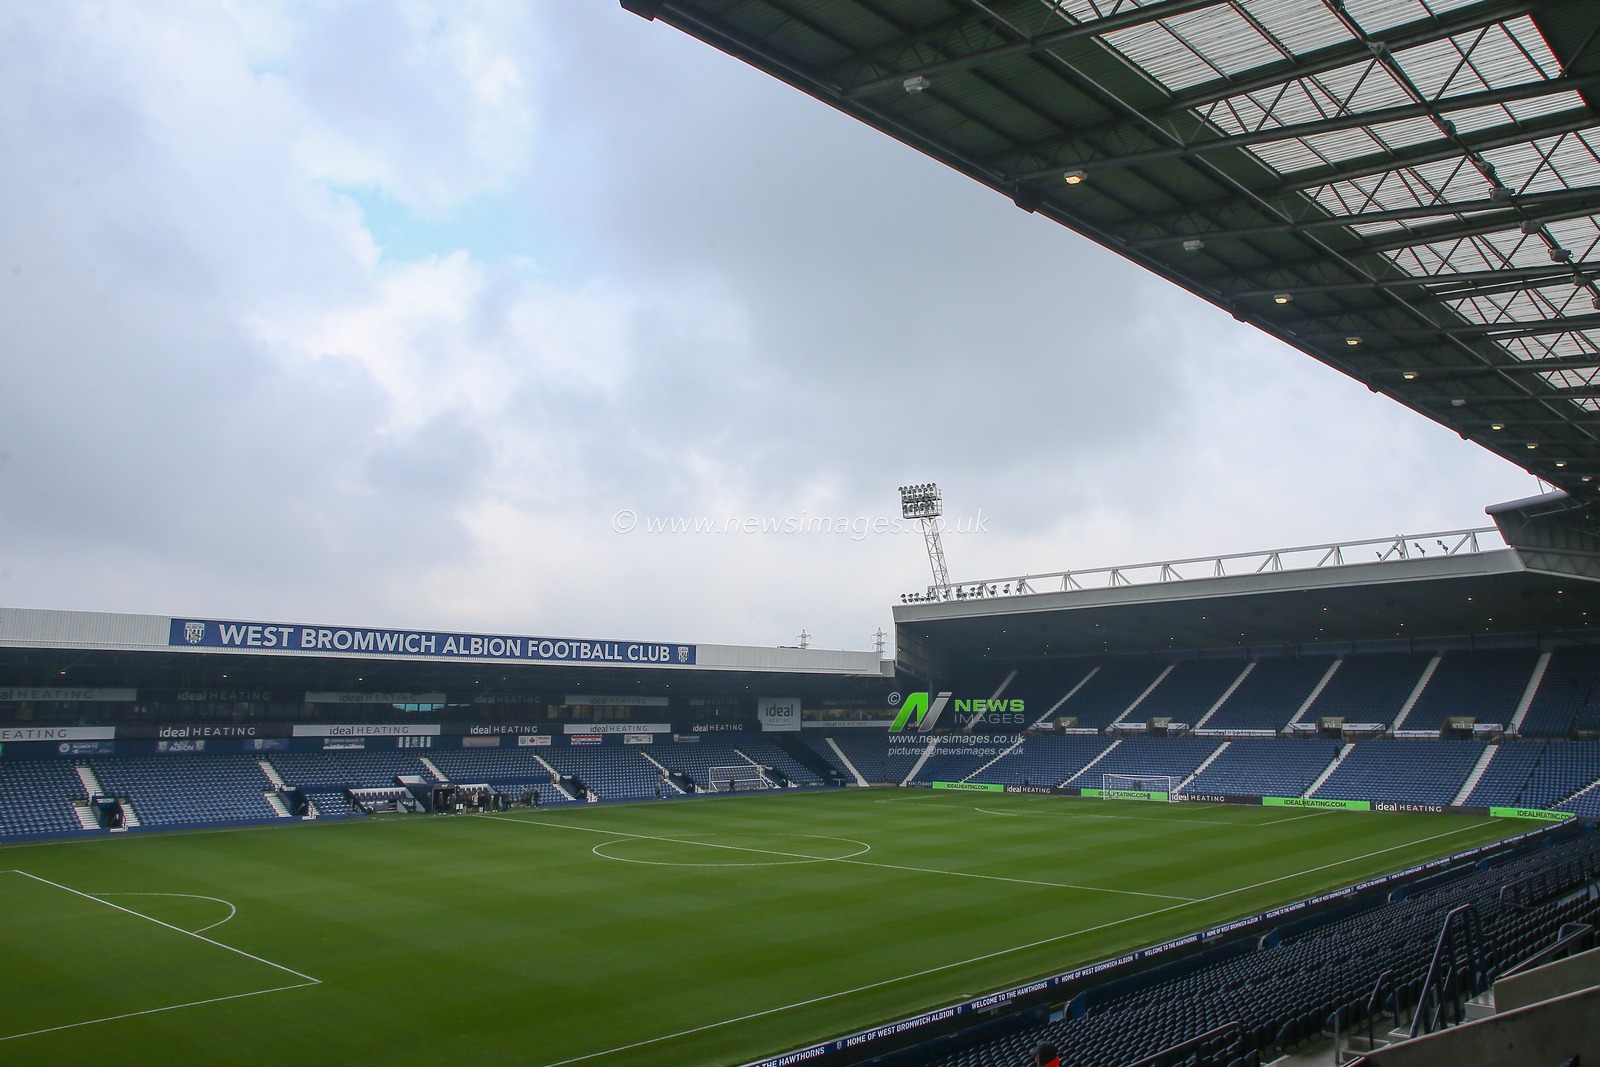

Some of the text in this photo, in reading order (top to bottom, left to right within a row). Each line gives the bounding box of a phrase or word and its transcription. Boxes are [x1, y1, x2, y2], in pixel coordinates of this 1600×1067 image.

[218, 624, 670, 662] WEST BROMWICH ALBION FOOTBALL CLUB
[17, 690, 93, 700] HEATING
[177, 691, 271, 701] ideal HEATING
[339, 693, 417, 703] ideal HEATING
[474, 695, 541, 704] ideal HEATING
[589, 697, 647, 705] ideal HEATING
[689, 698, 739, 706] ideal HEATING
[765, 704, 794, 717] ideal
[159, 726, 256, 738] ideal HEATING
[329, 725, 409, 736] ideal HEATING
[470, 725, 538, 734] ideal HEATING
[590, 725, 608, 733] ideal
[692, 724, 709, 732] ideal
[947, 783, 989, 791] IDEALHEATING.COM
[1006, 785, 1021, 793] ideal
[1172, 793, 1189, 801] ideal
[1283, 799, 1347, 808] IDEALHEATING.COM
[1375, 802, 1442, 813] ideal HEATING
[1061, 973, 1075, 983] HOME
[1081, 967, 1094, 977] WEST
[971, 981, 1048, 1010] WELCOME TO THE HAWTHORNS
[847, 1009, 954, 1047] HOME OF WEST BROMWICH ALBION
[779, 1046, 825, 1067] HAWTHORNS
